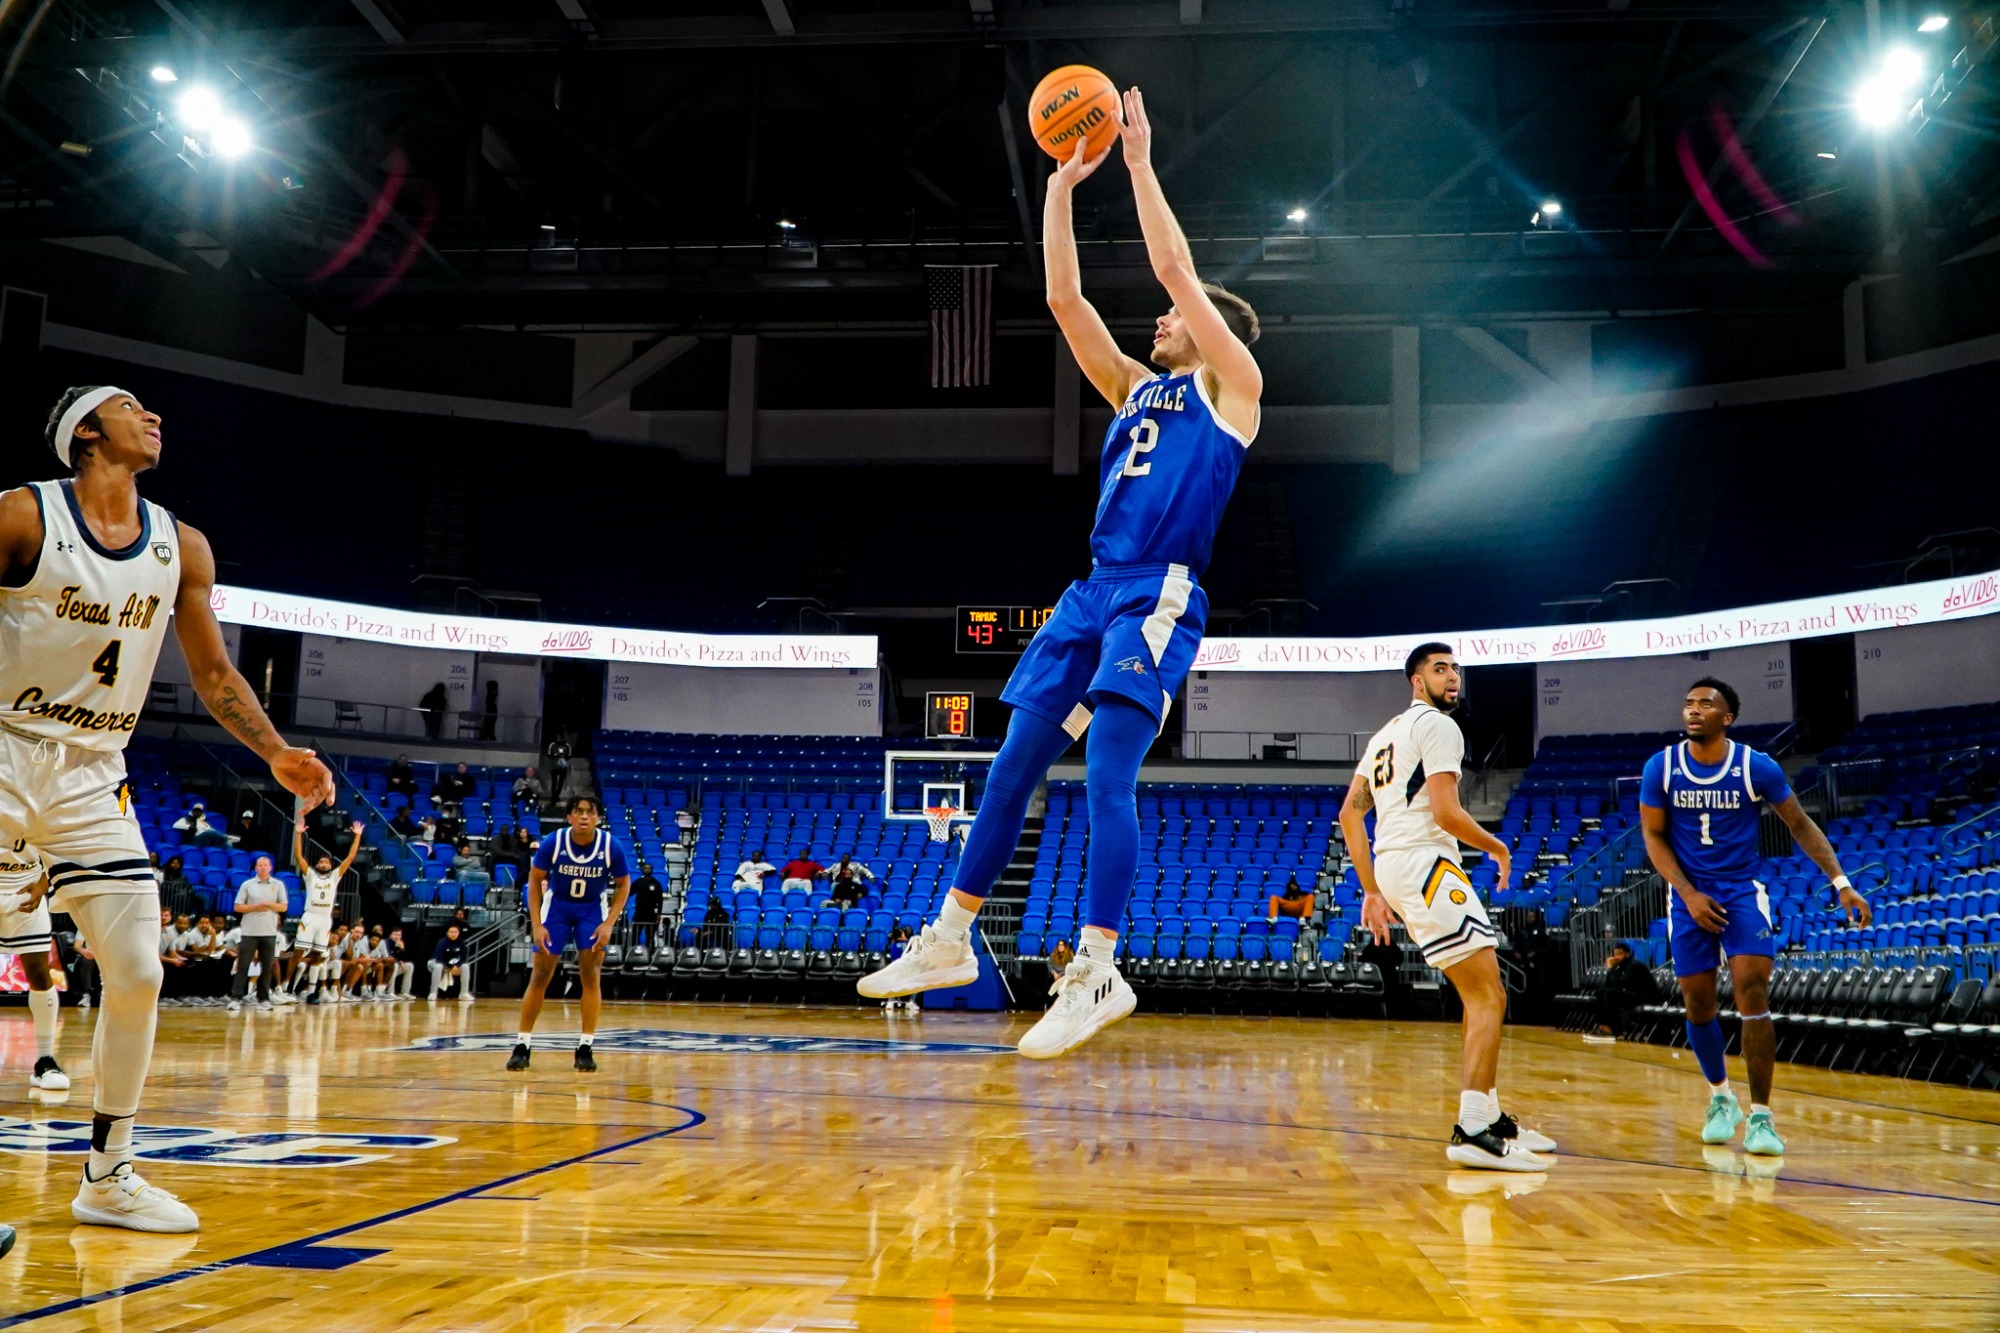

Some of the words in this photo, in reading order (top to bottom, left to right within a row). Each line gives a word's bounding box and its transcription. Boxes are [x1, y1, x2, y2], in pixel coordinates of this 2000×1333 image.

[1048, 106, 1105, 146] Wilson
[56, 585, 112, 626] Texas
[118, 592, 160, 630] A&M
[969, 611, 998, 622] TAMUC
[250, 601, 338, 630] Davido's
[345, 614, 394, 637] Pizza
[400, 623, 435, 642] and
[444, 626, 508, 652] Wings
[1646, 623, 1732, 650] Davido's
[1739, 617, 1791, 639] Pizza
[1799, 606, 1836, 631] and
[1844, 601, 1919, 627] Wings
[968, 624, 993, 645] 43
[611, 638, 691, 659] Davido's
[698, 644, 744, 662] Pizza
[750, 644, 783, 662] and
[790, 645, 850, 668] Wings
[1258, 643, 1366, 663] daVIDOS's
[1373, 644, 1412, 662] Pizz
[1470, 638, 1537, 660] Wings
[1862, 648, 1882, 660] 210
[92, 638, 122, 688] 4
[1767, 661, 1785, 671] 210
[614, 675, 630, 684] 207
[858, 682, 873, 691] 208
[1544, 678, 1561, 688] 209
[1767, 680, 1784, 690] 107
[613, 692, 628, 701] 105
[1193, 685, 1209, 694] 208
[858, 699, 872, 708] 105
[936, 696, 969, 710] 11:03
[1193, 703, 1208, 711] 106
[1544, 696, 1560, 705] 107
[950, 710, 965, 735] 8
[1673, 790, 1741, 809] ASHEVILLE
[1699, 813, 1714, 845] 1
[558, 864, 603, 878] ASHEVILLE
[570, 878, 587, 898] 0
